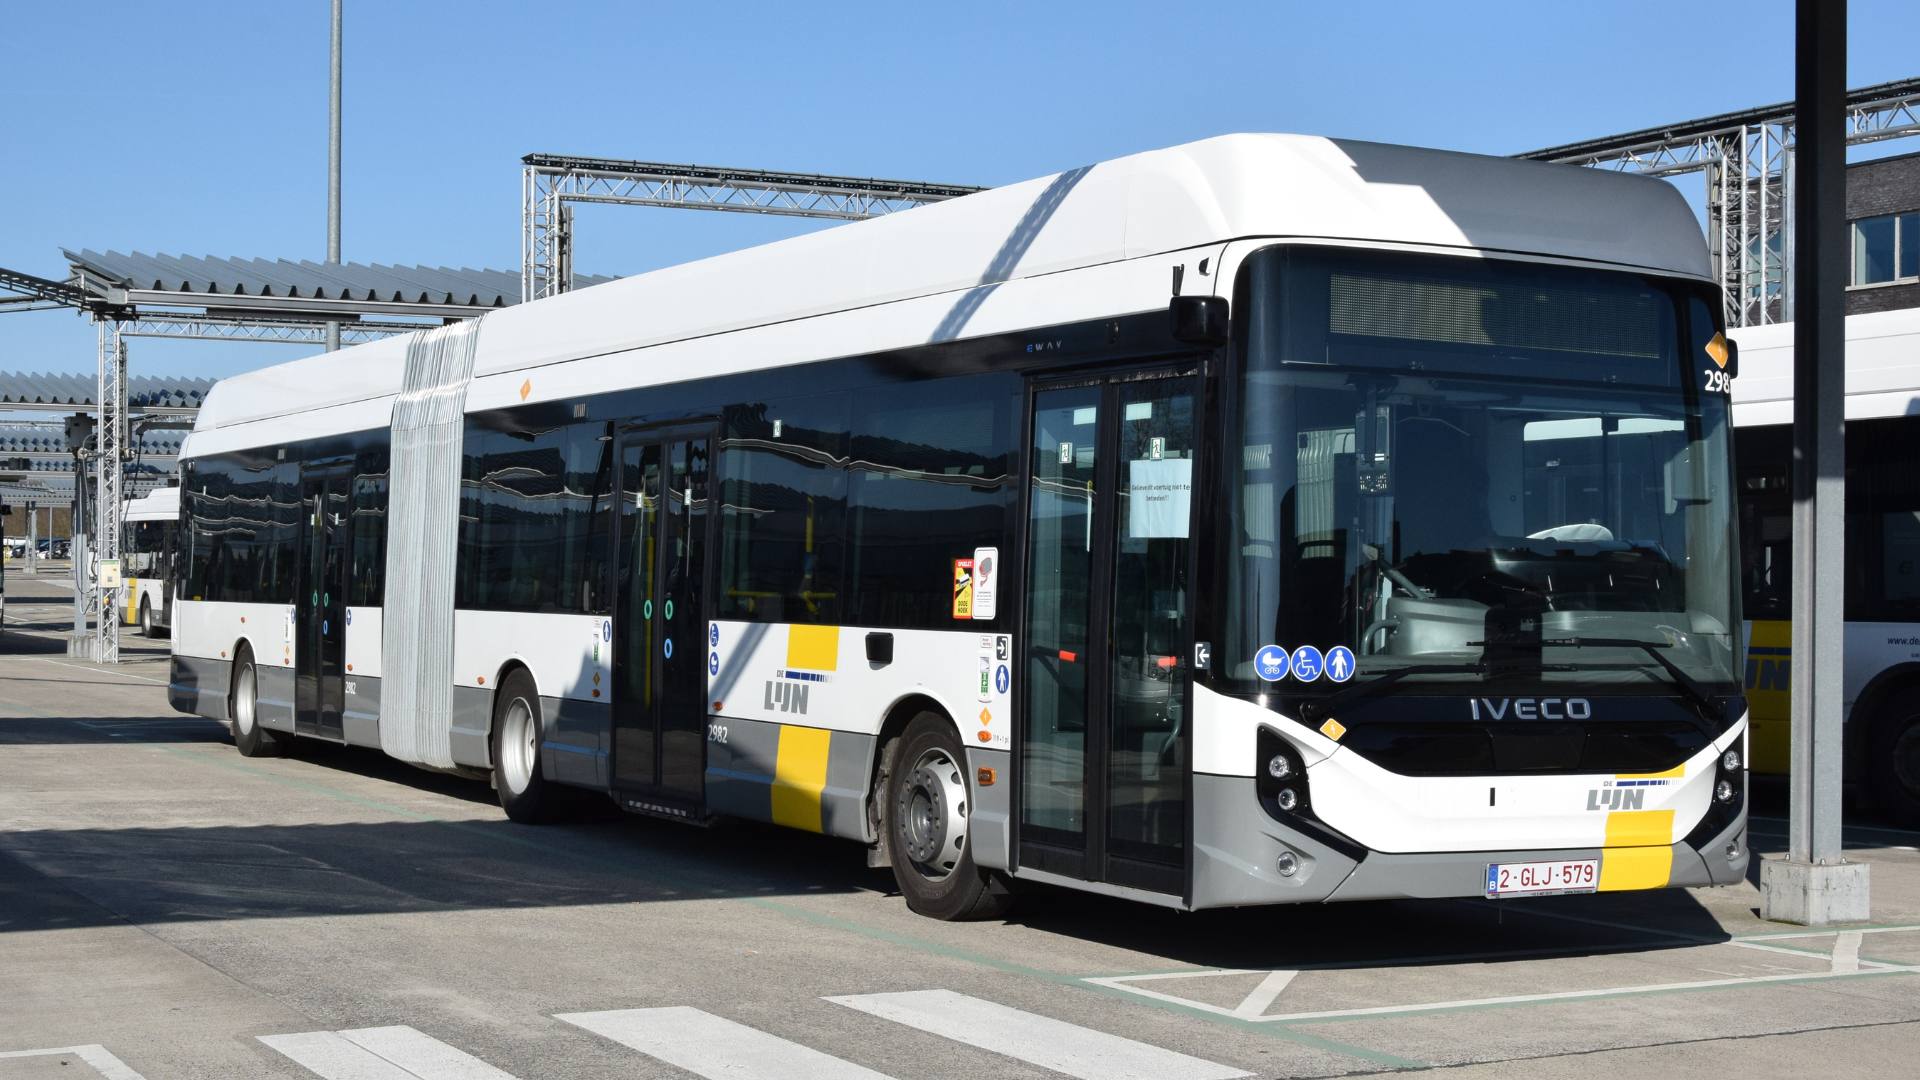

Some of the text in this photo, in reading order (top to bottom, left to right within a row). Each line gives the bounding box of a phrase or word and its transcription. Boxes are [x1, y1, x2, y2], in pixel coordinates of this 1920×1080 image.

[1704, 369, 1730, 394] 298
[764, 680, 809, 714] LIJN
[1470, 698, 1591, 720] IVECO
[708, 724, 728, 744] 2982
[1586, 788, 1645, 811] LIJN
[1489, 880, 1497, 890] B
